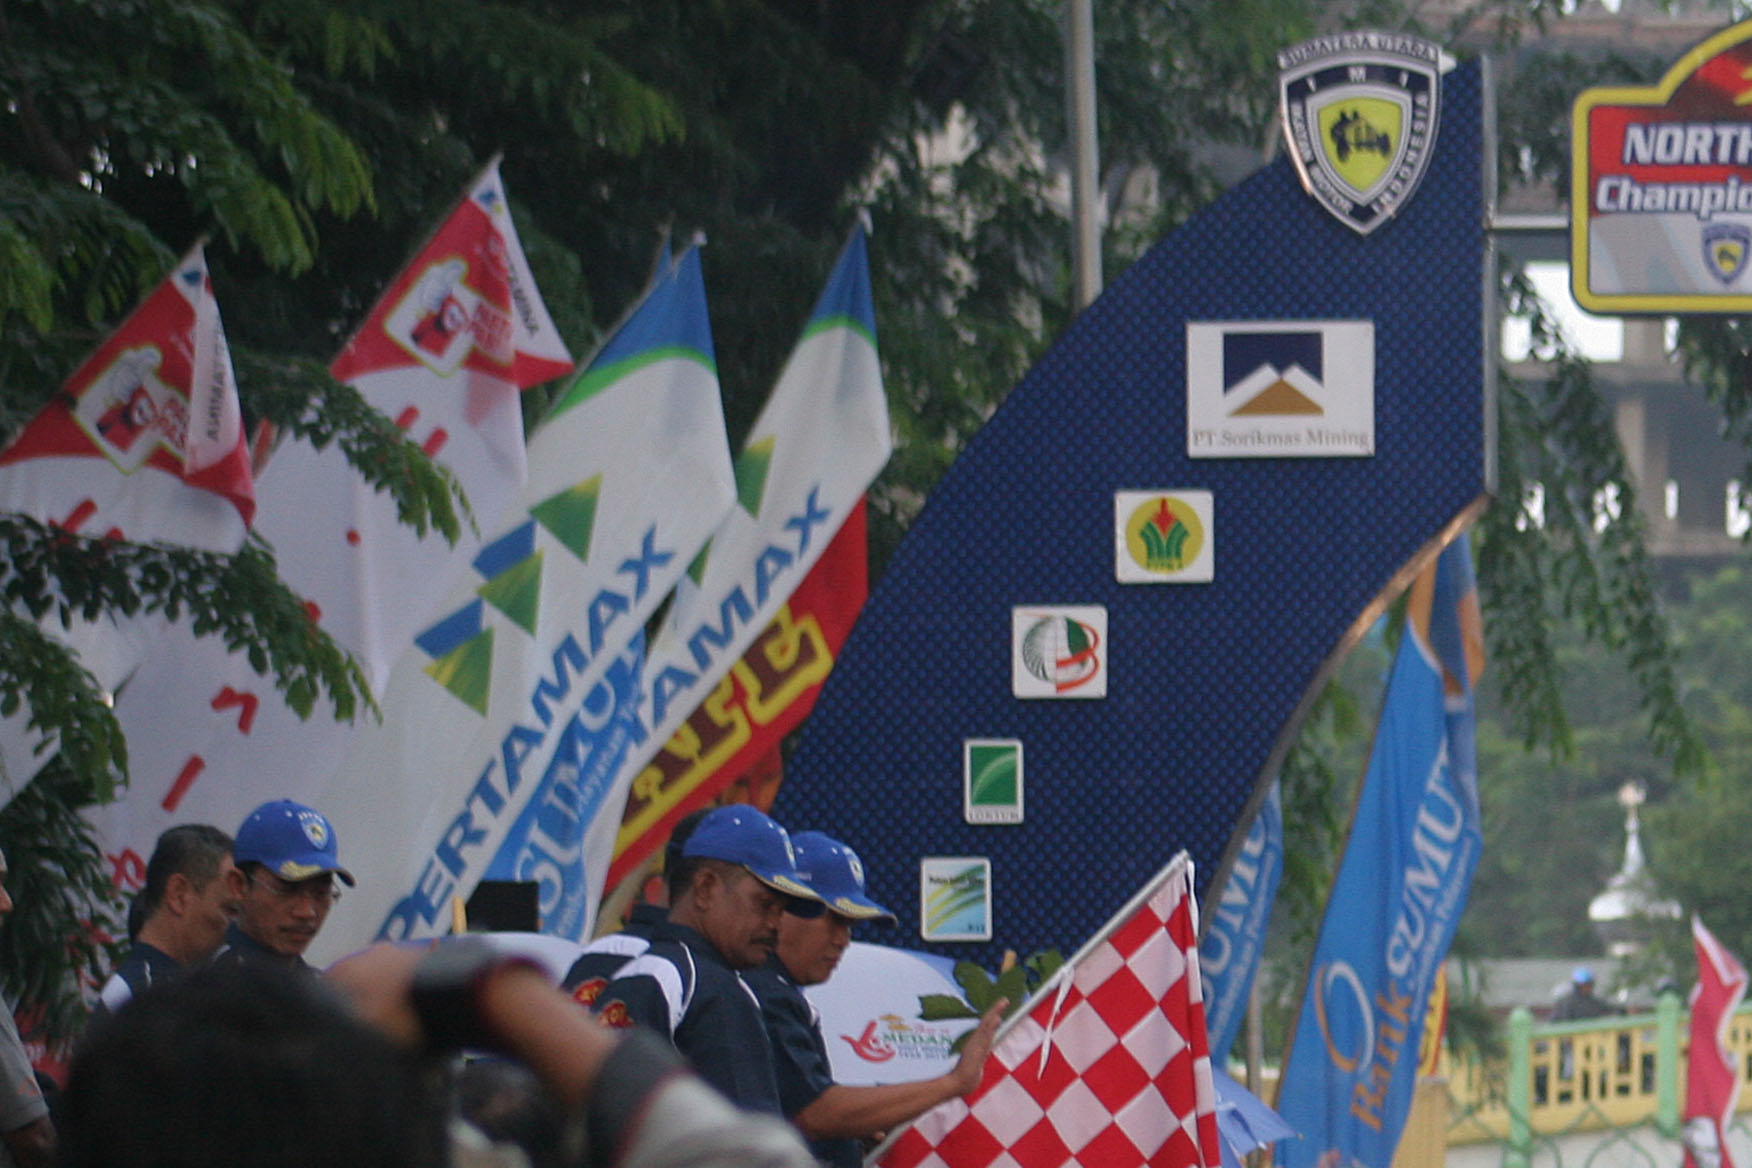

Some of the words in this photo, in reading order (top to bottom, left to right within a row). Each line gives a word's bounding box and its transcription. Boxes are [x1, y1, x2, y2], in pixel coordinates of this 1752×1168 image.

[1192, 430, 1216, 447] PT
[1220, 428, 1300, 447] Sorikmas
[1305, 428, 1370, 450] Mining
[373, 522, 676, 942] PERTAMAX
[1350, 978, 1413, 1133] Bank
